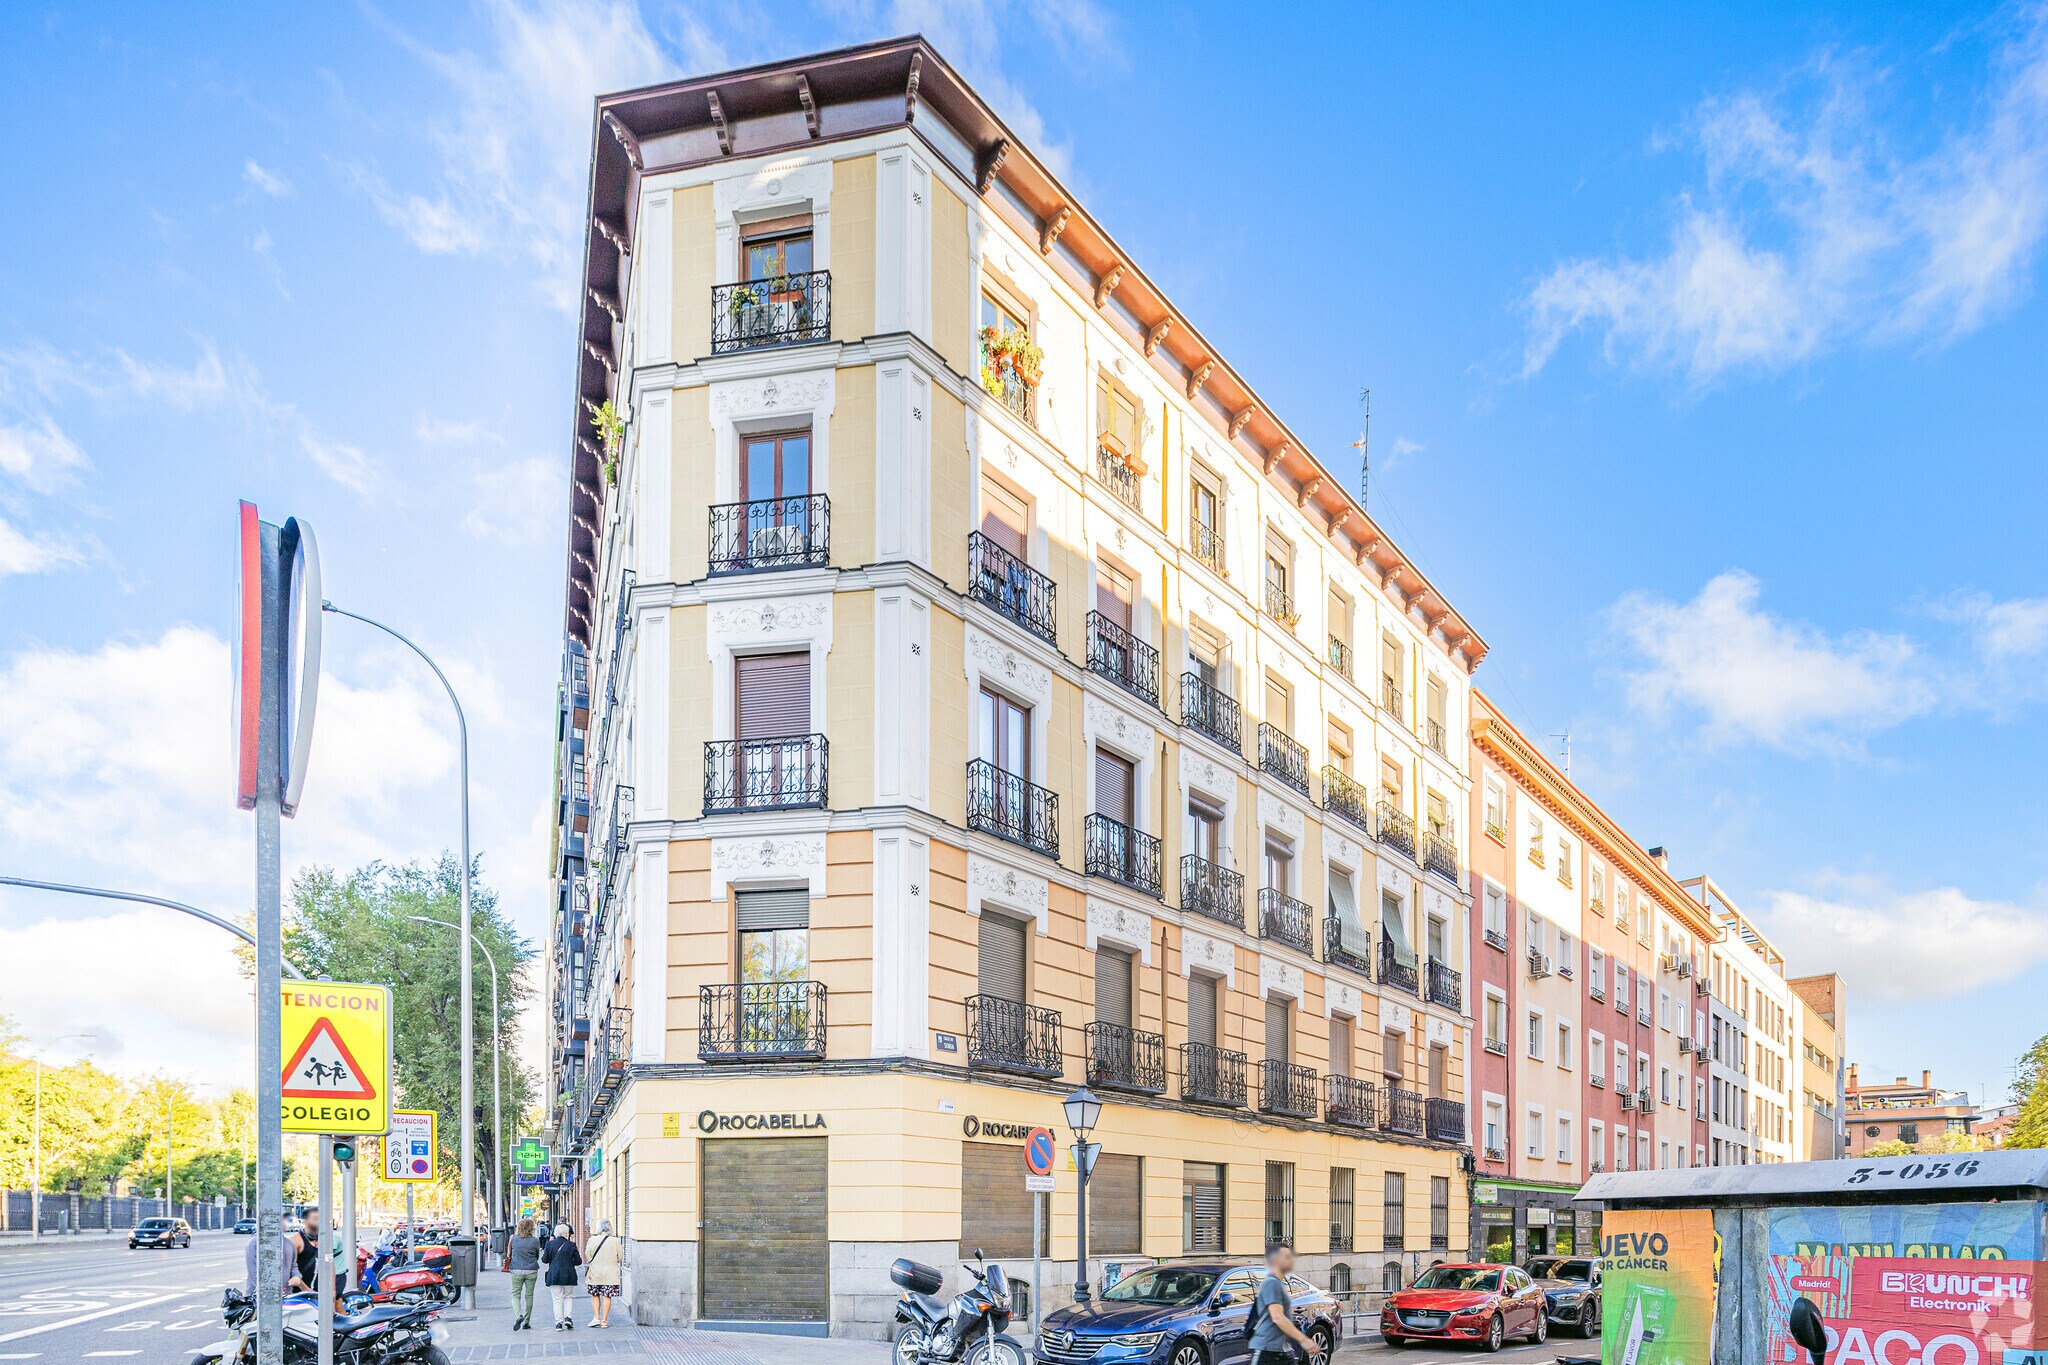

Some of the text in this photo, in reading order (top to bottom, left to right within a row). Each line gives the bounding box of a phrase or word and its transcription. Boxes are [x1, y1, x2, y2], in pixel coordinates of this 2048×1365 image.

[281, 992, 379, 1011] TENCION
[281, 1106, 370, 1121] COLEGIO
[392, 1117, 429, 1125] RECAUCION
[982, 1121, 1057, 1142] ROCABEA
[1600, 1232, 1669, 1258] UEVO
[1616, 1256, 1669, 1272] CÁNCER
[1798, 1279, 1831, 1289] Madrid!
[1881, 1271, 2029, 1299] BRUNCH!
[1910, 1297, 1992, 1313] Electronik
